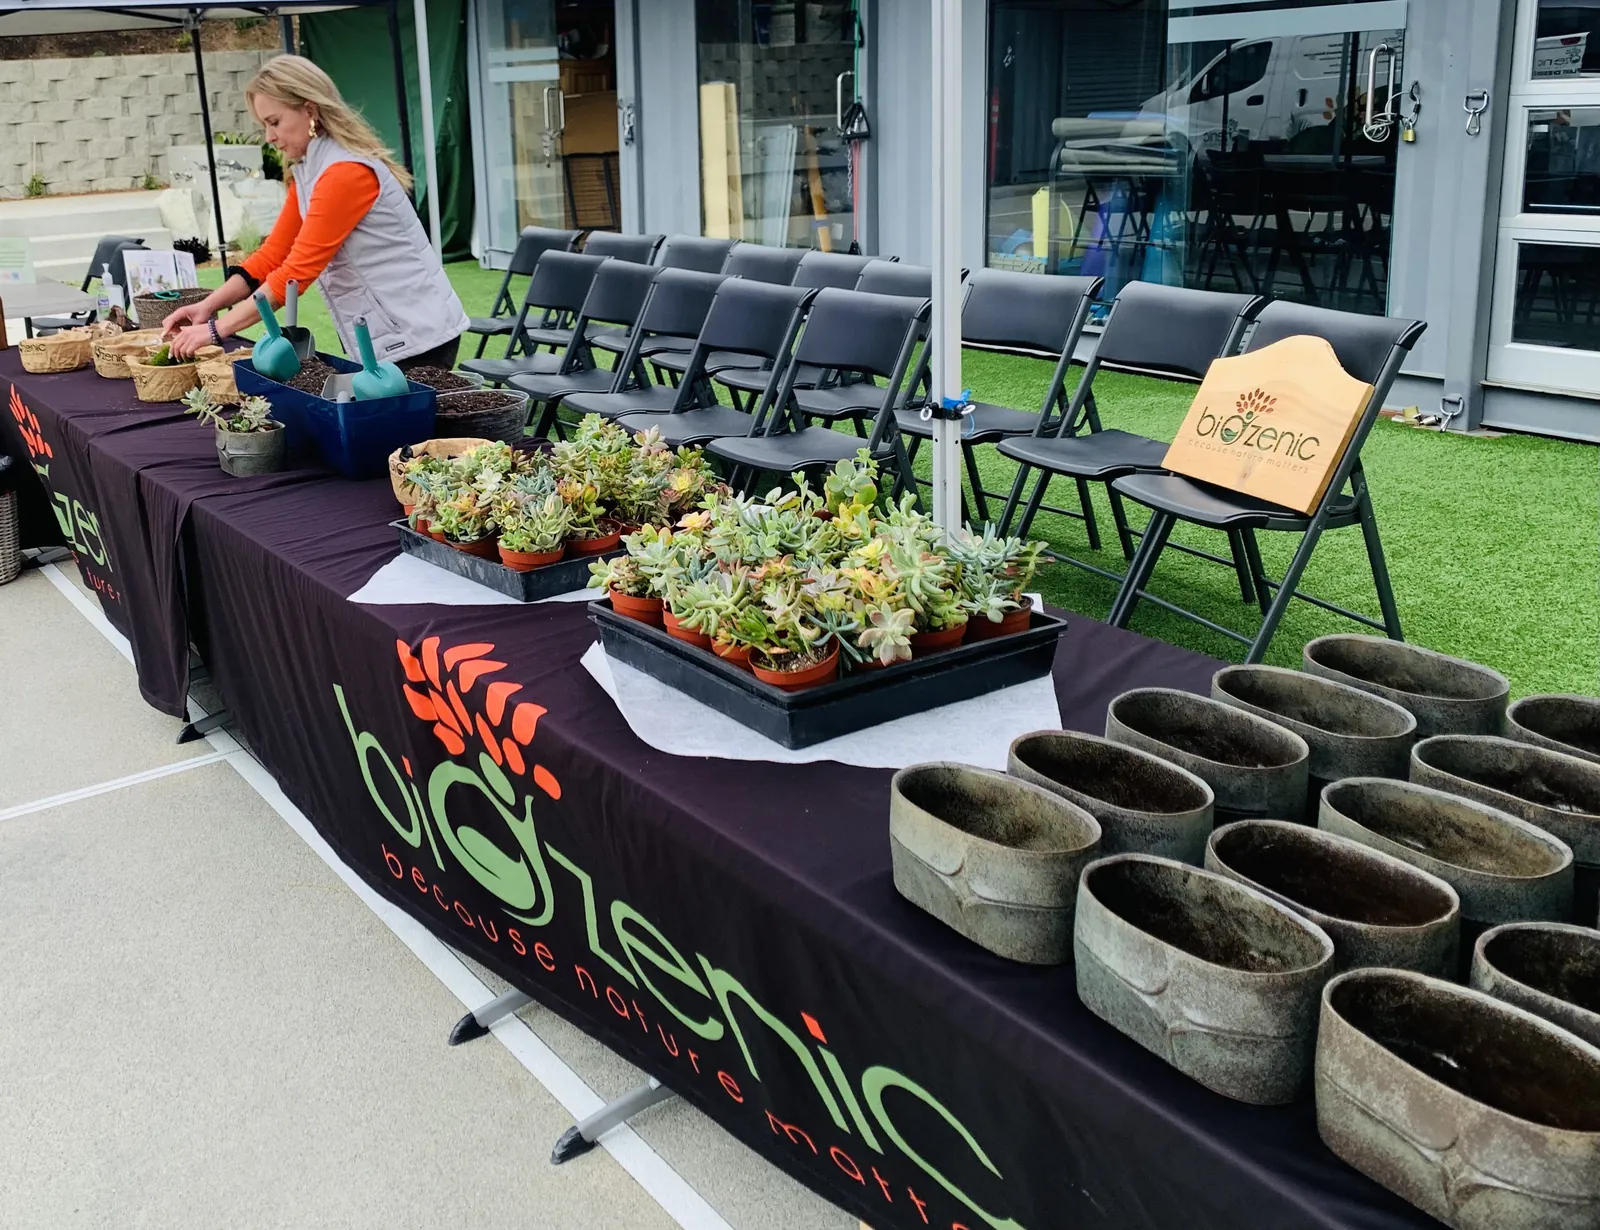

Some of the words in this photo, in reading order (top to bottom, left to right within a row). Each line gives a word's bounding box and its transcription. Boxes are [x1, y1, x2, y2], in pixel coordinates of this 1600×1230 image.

[1187, 438, 1229, 454] because
[1230, 449, 1264, 463] nature
[1266, 458, 1309, 474] matters
[1196, 406, 1320, 461] biozenic
[333, 684, 1028, 1230] biozenic
[381, 843, 555, 972] because
[574, 964, 744, 1103] nature
